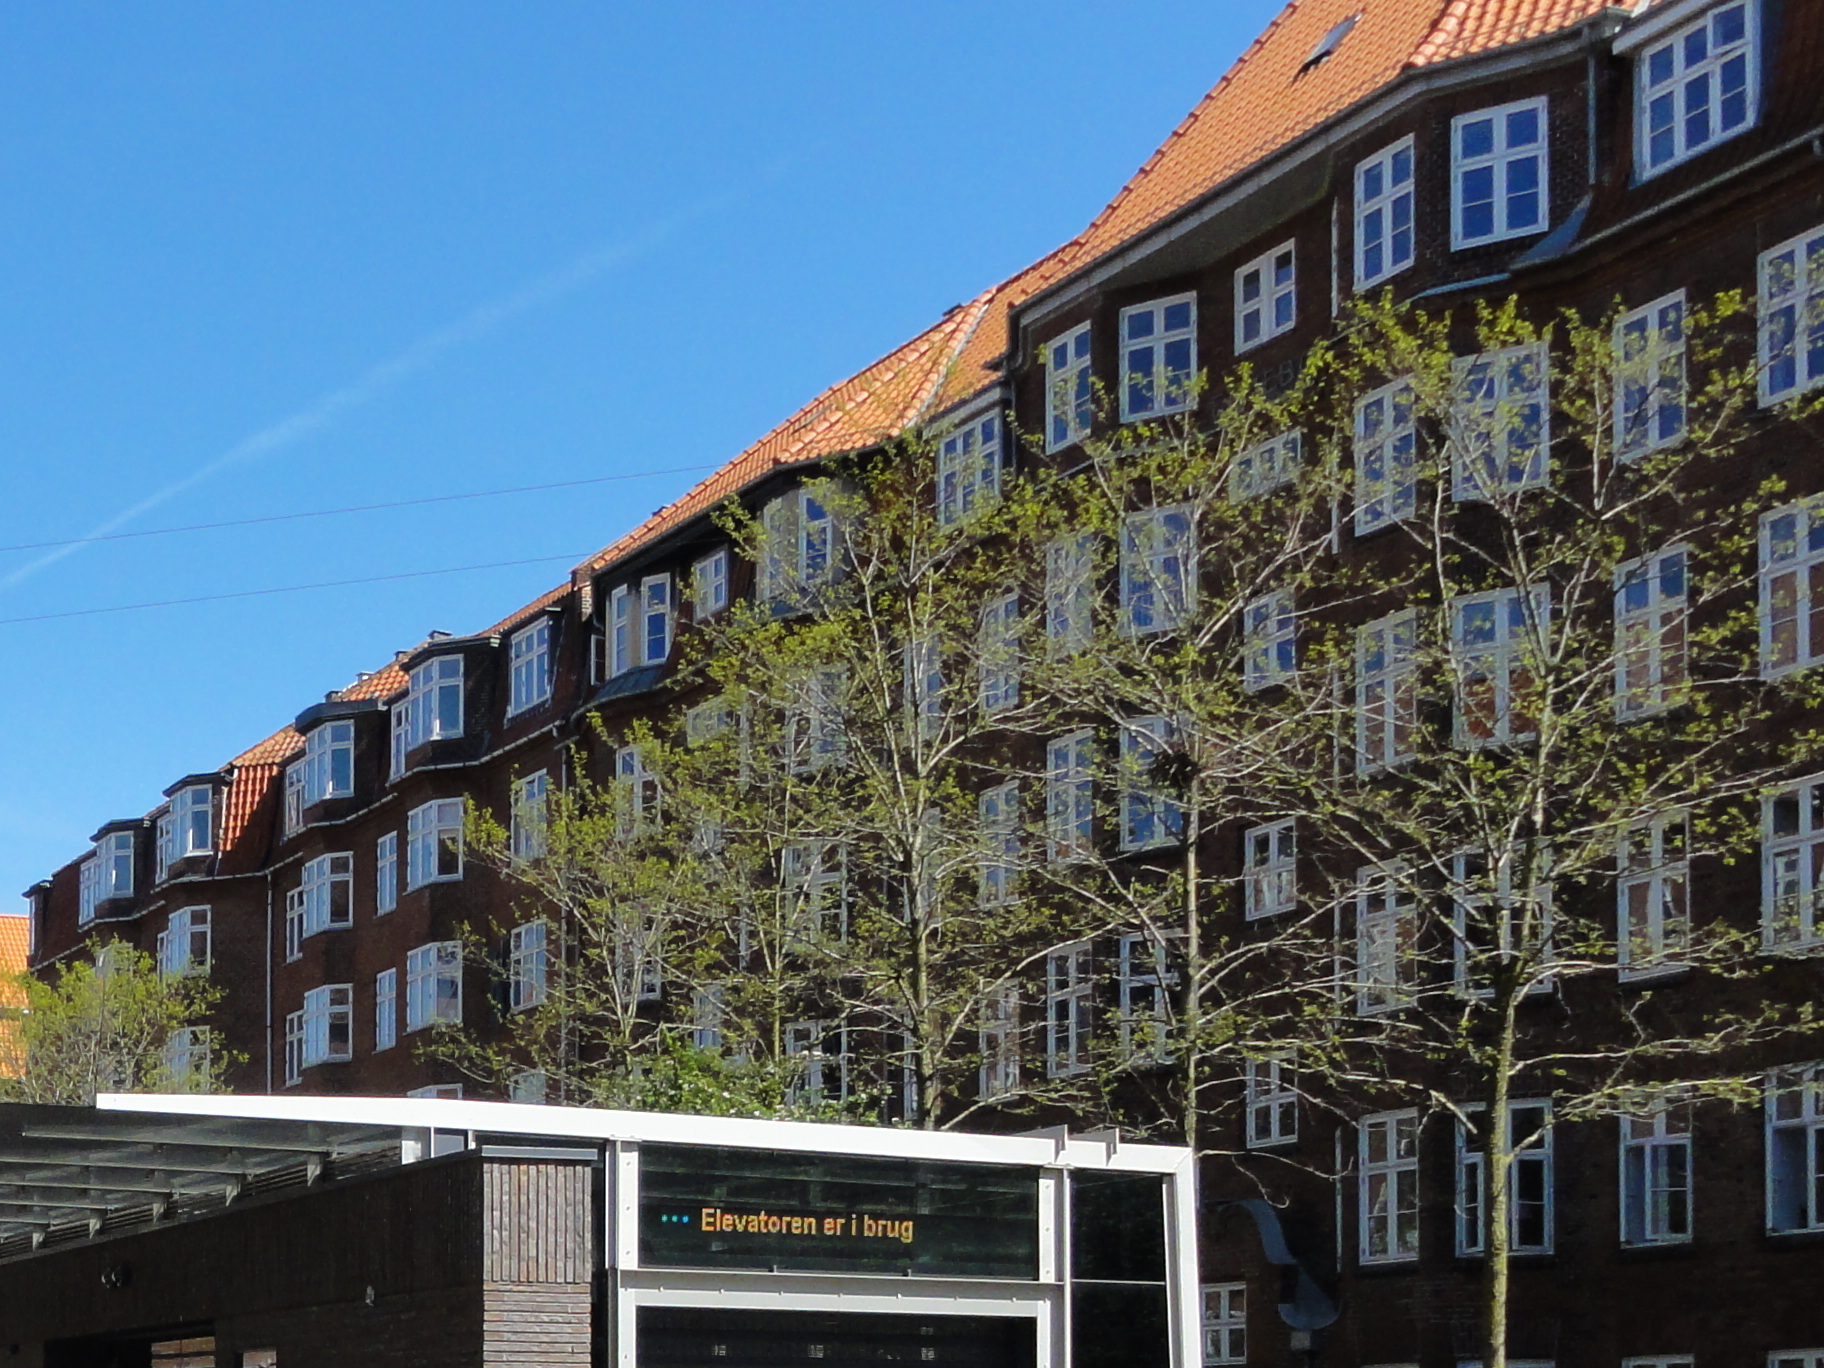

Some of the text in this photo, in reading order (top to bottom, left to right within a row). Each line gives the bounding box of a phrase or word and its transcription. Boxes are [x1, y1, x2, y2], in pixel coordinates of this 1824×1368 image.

[700, 1208, 915, 1244] Elevatoren er i brug
